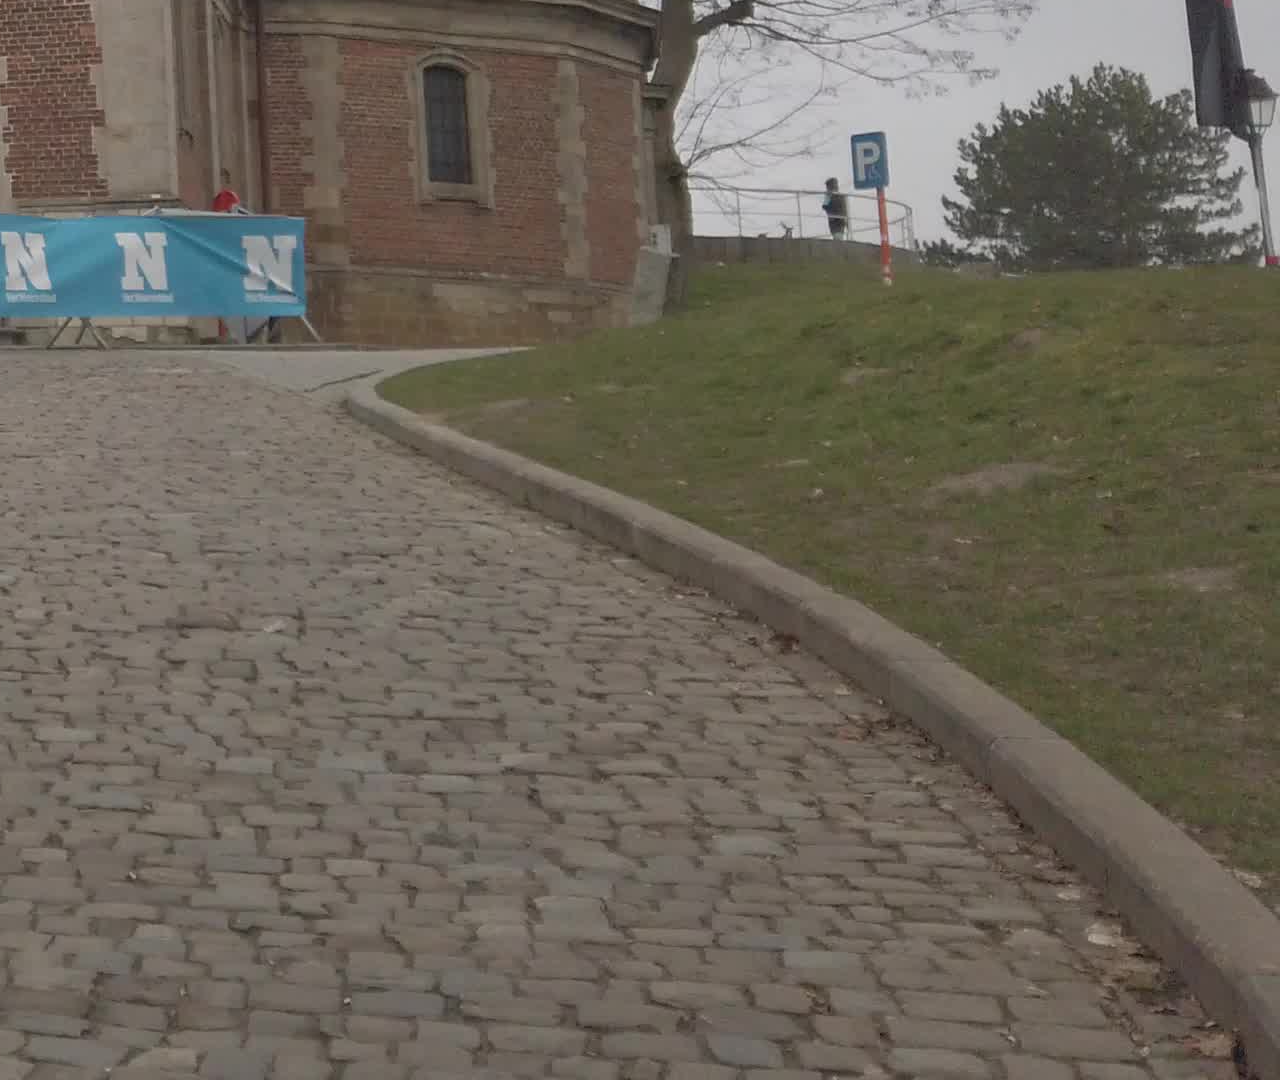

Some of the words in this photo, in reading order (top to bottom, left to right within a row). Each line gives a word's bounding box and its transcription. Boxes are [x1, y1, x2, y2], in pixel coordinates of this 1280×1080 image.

[856, 142, 881, 181] P
[0, 232, 52, 290] N
[114, 232, 168, 290] N
[242, 235, 297, 292] N
